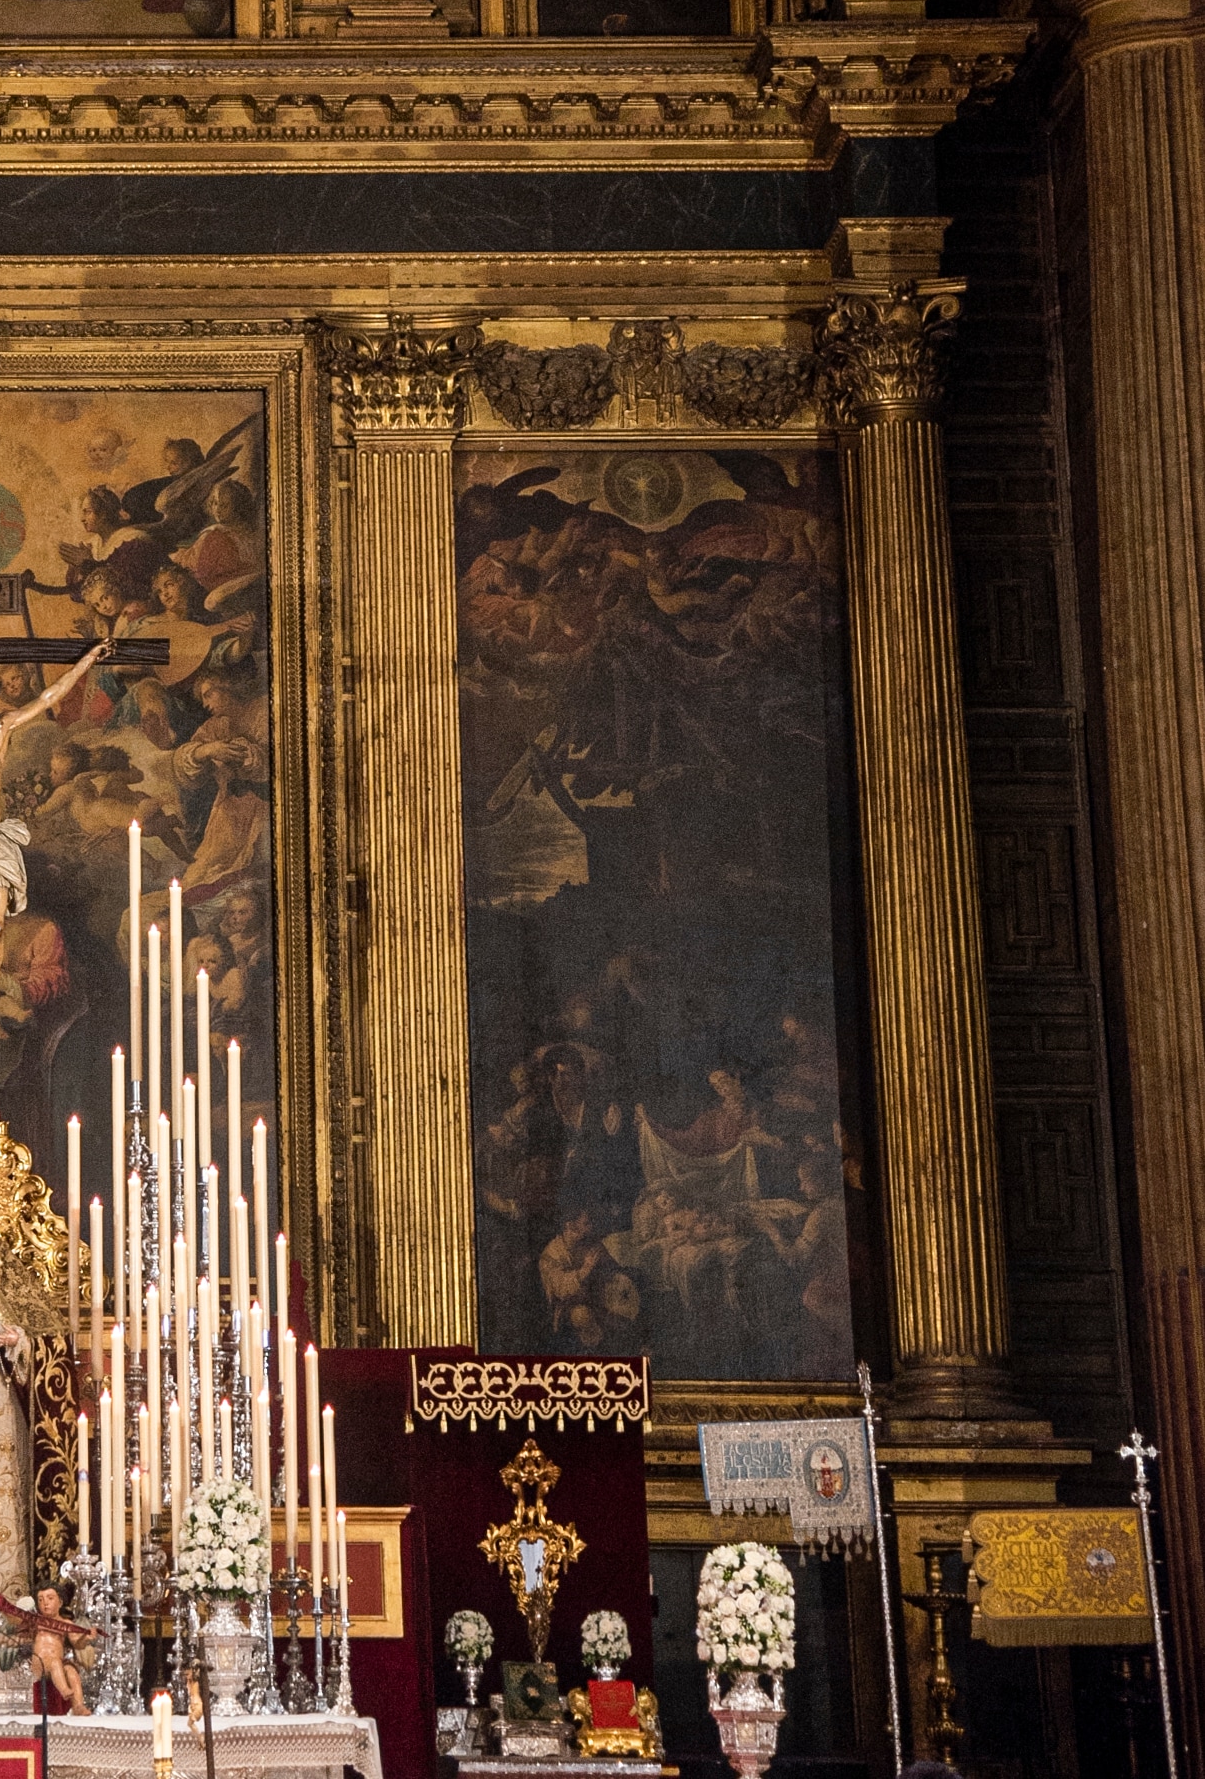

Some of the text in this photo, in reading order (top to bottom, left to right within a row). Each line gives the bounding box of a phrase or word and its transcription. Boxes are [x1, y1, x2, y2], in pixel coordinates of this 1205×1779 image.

[722, 1453, 791, 1468] FILOSOFIA
[992, 1541, 1060, 1557] FACULTAD
[1019, 1556, 1039, 1571] DE
[998, 1570, 1064, 1587] MEDICINA
